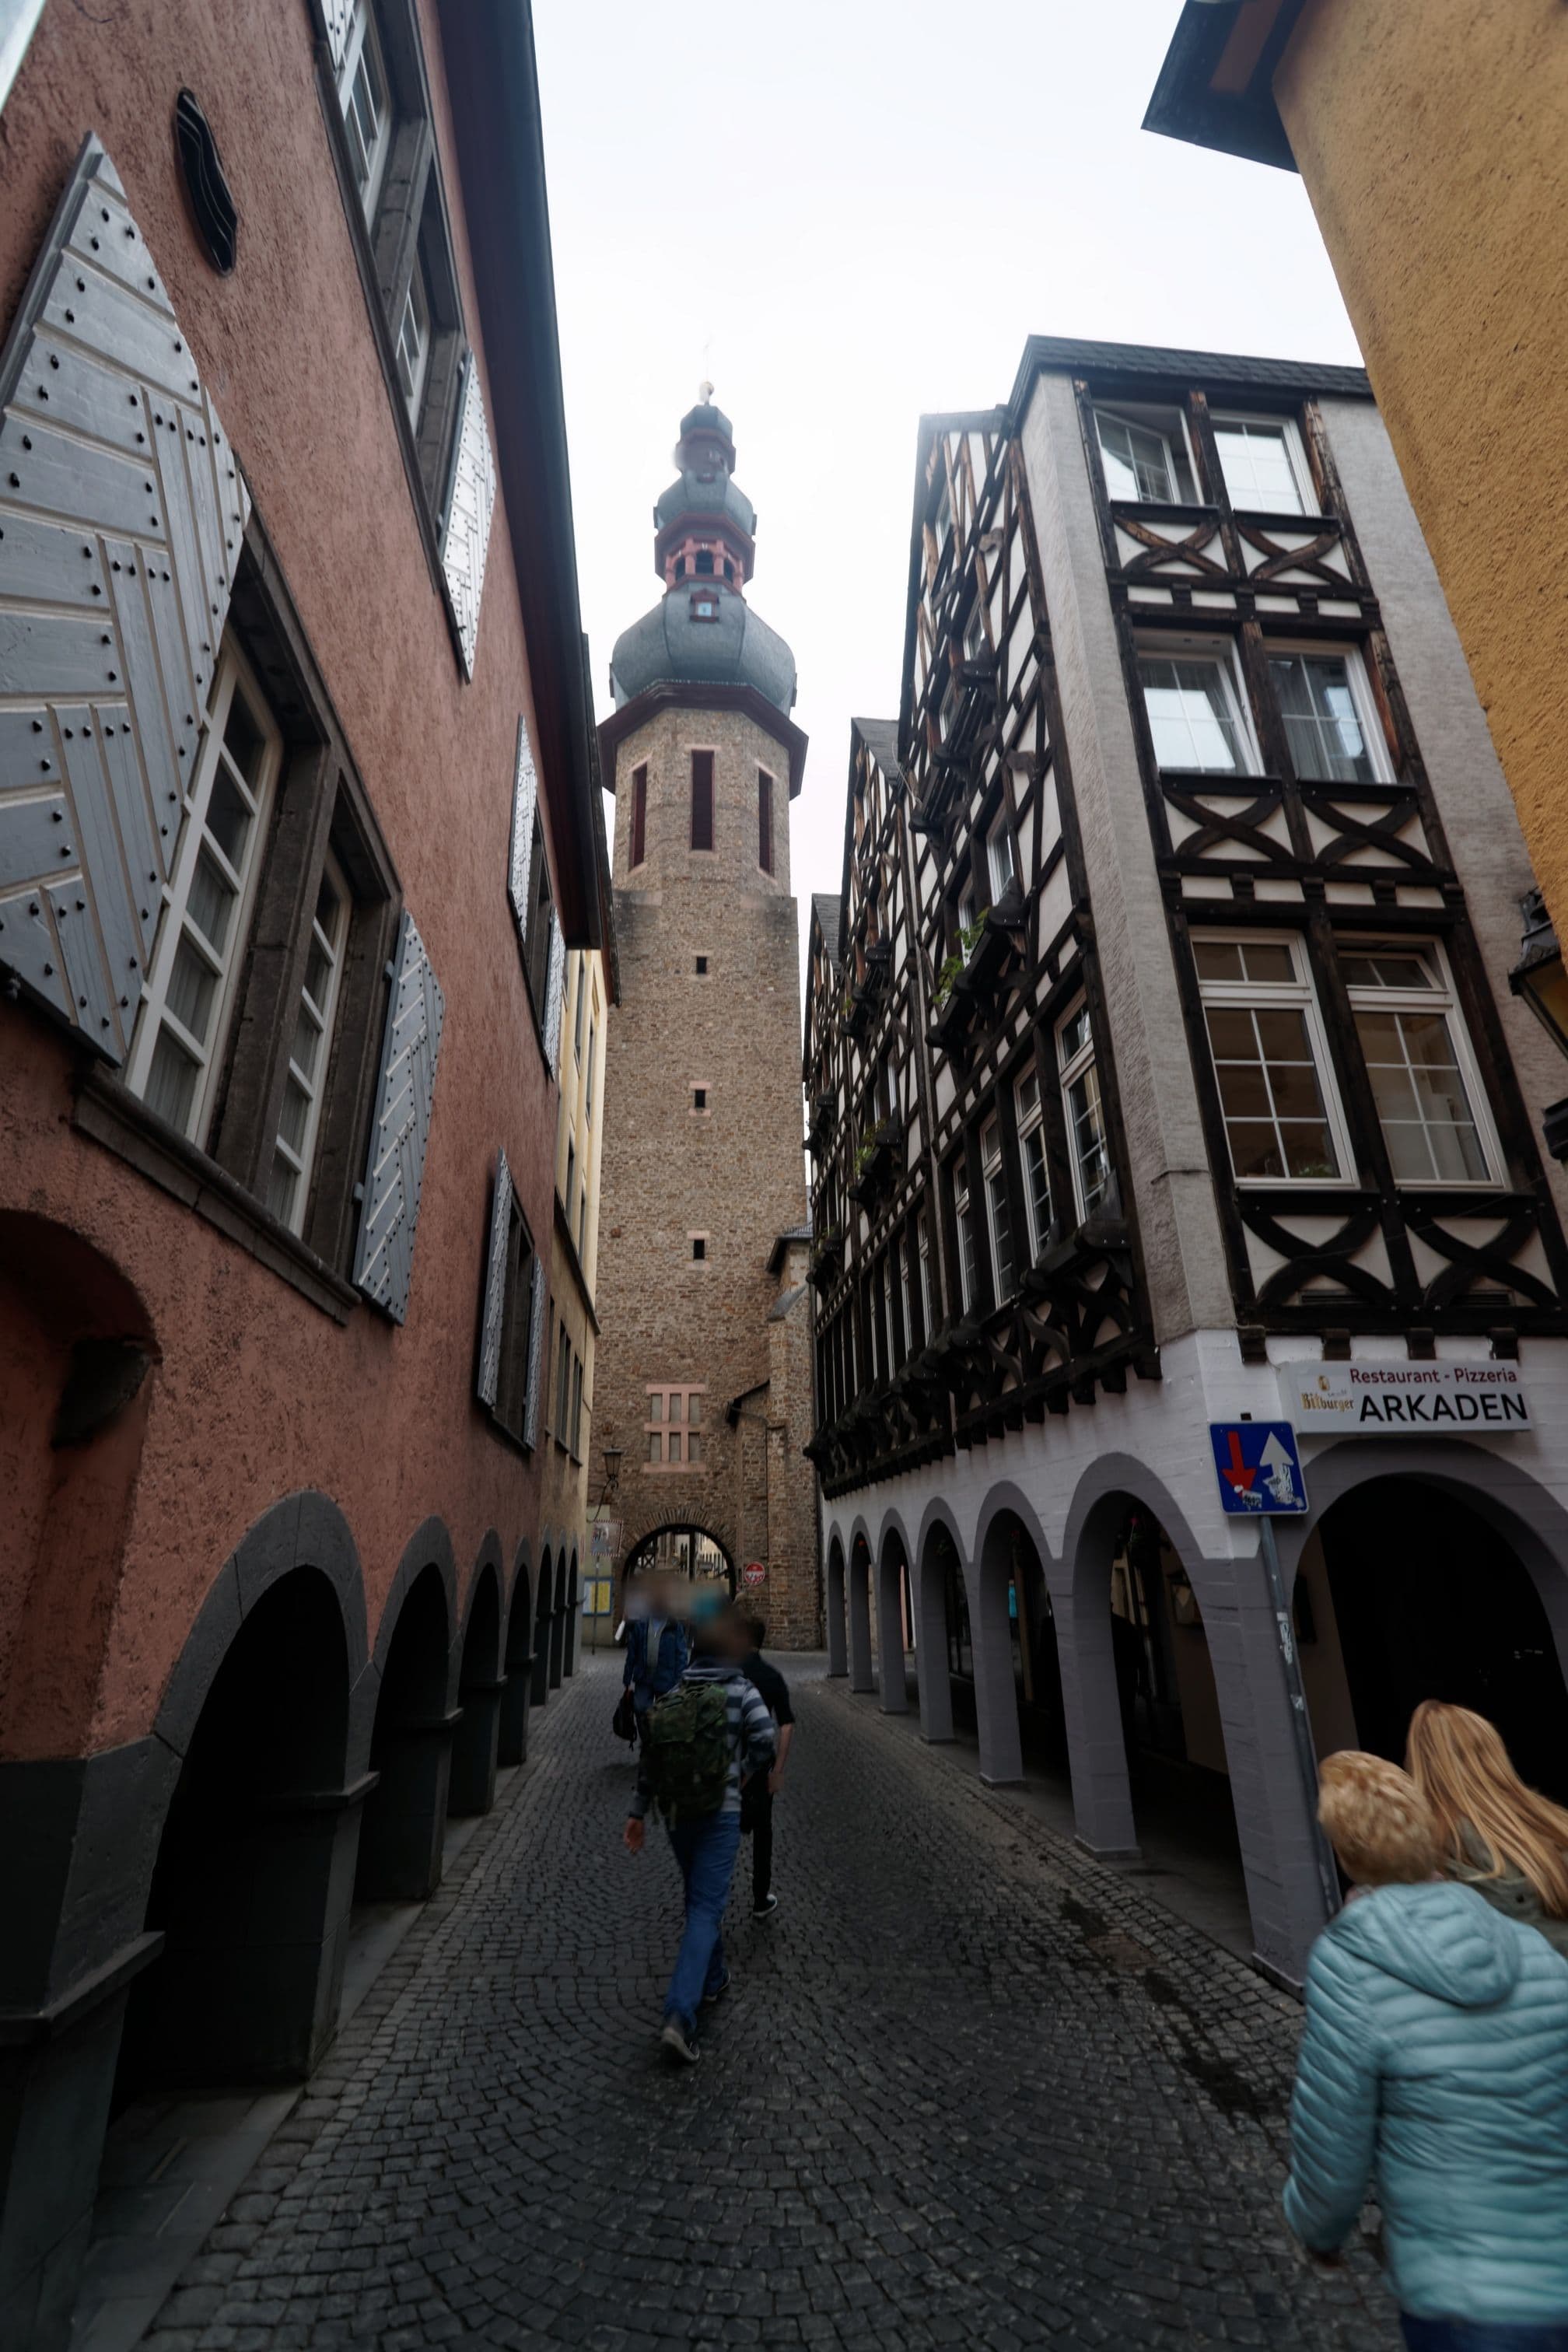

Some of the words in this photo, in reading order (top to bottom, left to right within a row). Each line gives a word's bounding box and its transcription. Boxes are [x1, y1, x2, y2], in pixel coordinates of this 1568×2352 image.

[1349, 1368, 1439, 1383] Restaurant
[1454, 1367, 1517, 1383] Pizzeria
[1301, 1392, 1354, 1412] Bitburger
[1360, 1393, 1528, 1422] ARKADEN
